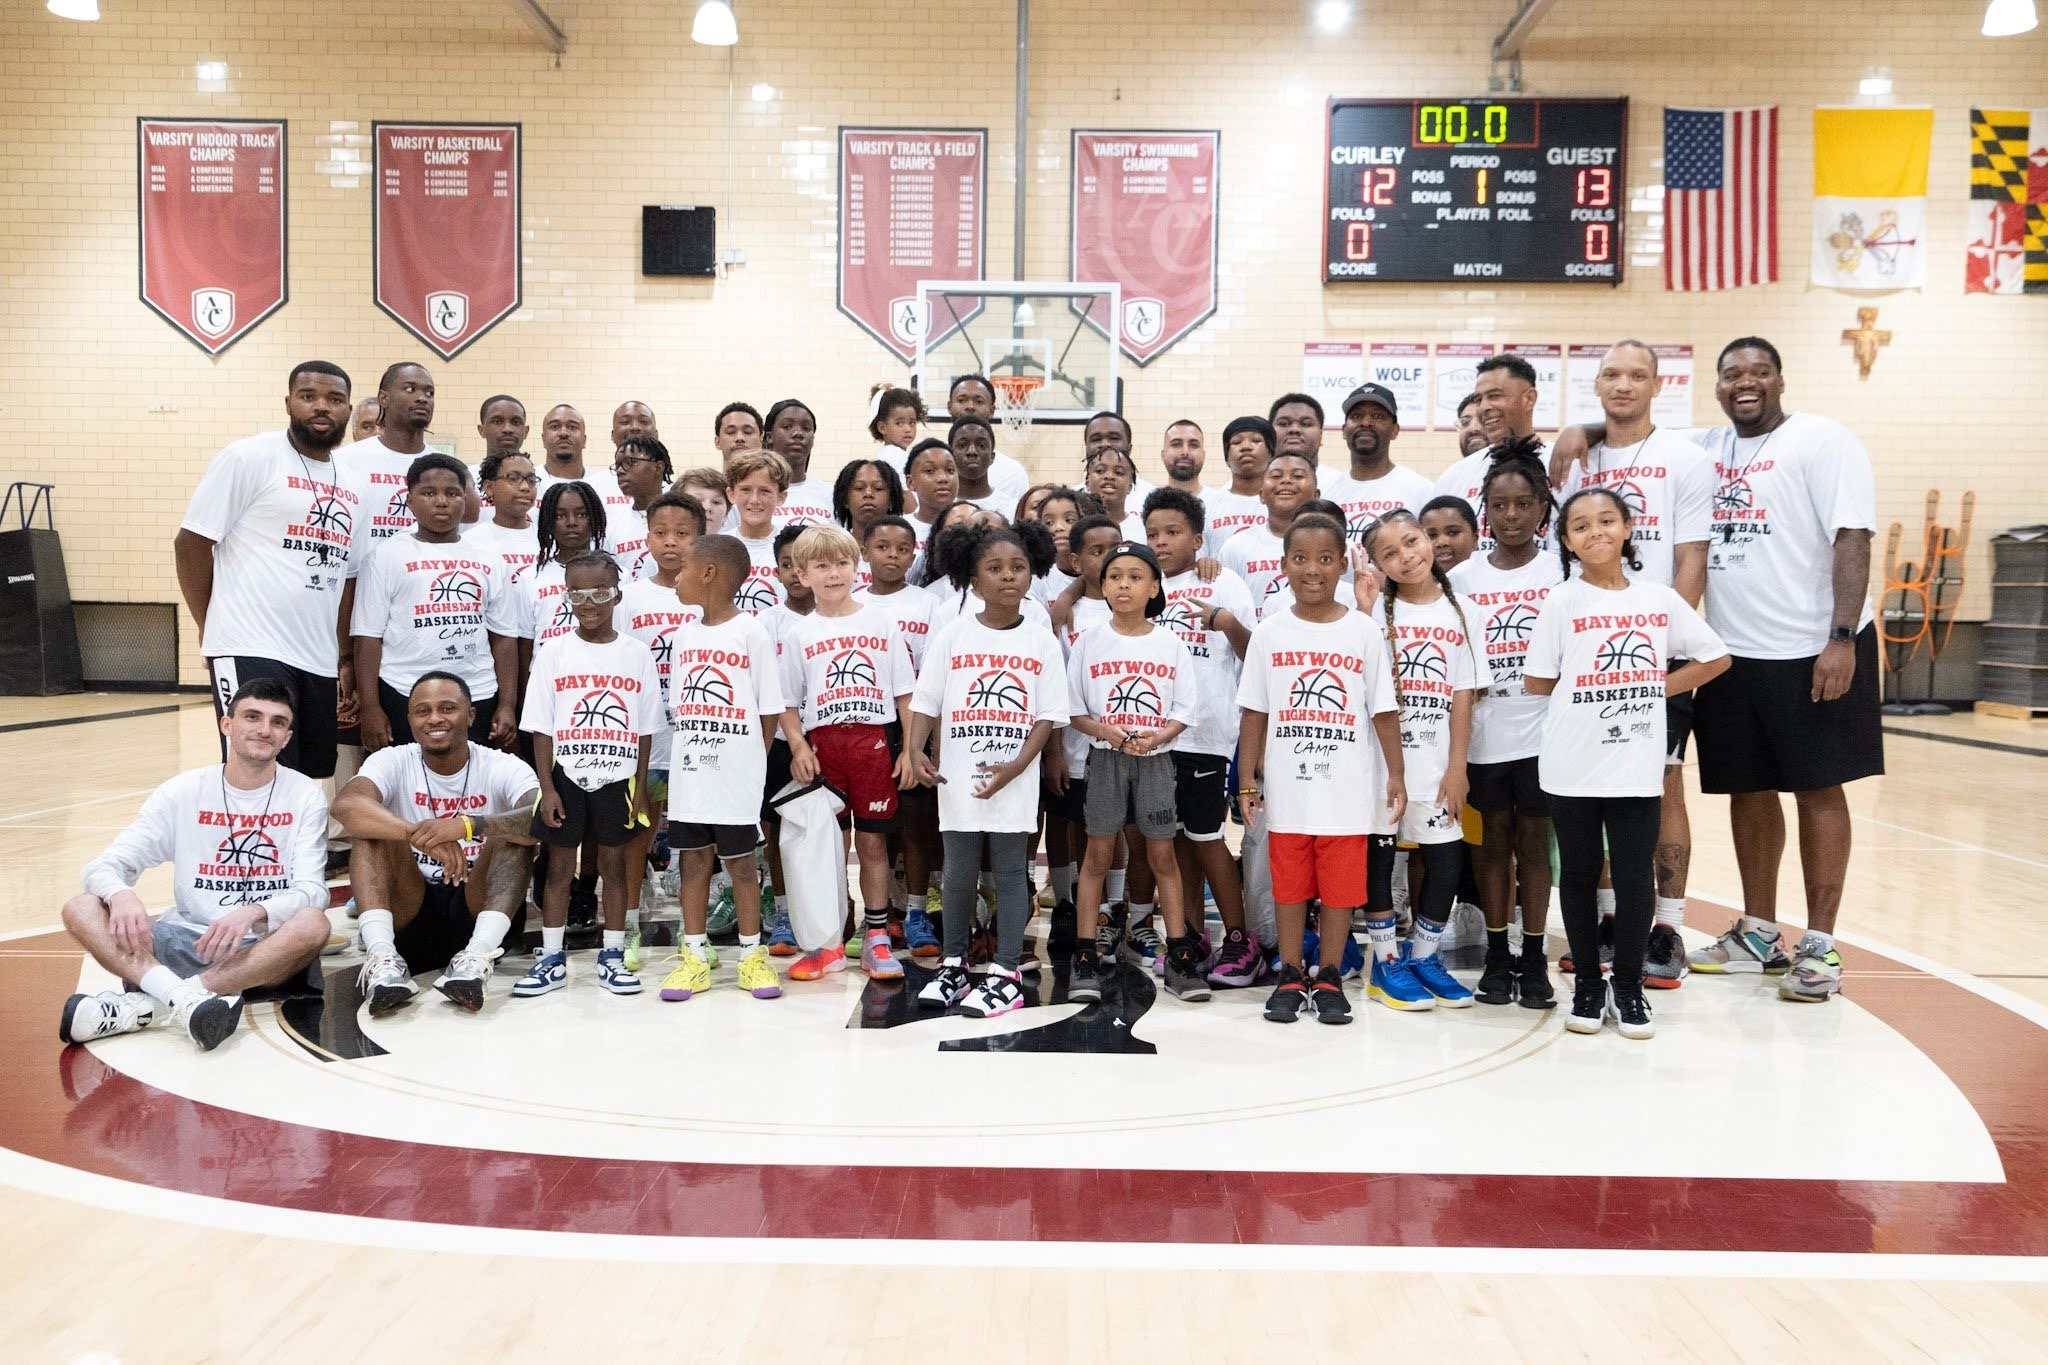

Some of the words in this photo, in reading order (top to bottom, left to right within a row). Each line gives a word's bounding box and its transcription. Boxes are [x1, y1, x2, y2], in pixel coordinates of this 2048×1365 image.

[1420, 106, 1507, 143] 00.0
[150, 132, 193, 146] VARSITY
[196, 133, 238, 147] INDOOR
[240, 134, 275, 148] TRACK
[390, 136, 434, 150] VARSITY
[438, 137, 502, 151] BASKETBALL
[190, 148, 235, 161] CHAMPS
[850, 142, 894, 155] VARSITY
[896, 142, 932, 156] TRACK
[934, 142, 942, 156] &
[945, 142, 976, 156] FIELD
[1093, 143, 1138, 157] VARSITY
[1140, 143, 1198, 158] SWIMMING
[1331, 147, 1406, 164] CURLEY
[424, 151, 469, 165] CHAMPS
[890, 156, 936, 170] CHAMPS
[1450, 156, 1500, 168] PERIOD
[1546, 148, 1617, 165] GUEST
[196, 166, 234, 174] CONFERENCE
[1122, 158, 1168, 172] CHAMPS
[430, 170, 468, 178] CONFERENCE
[1412, 171, 1444, 184] POSS
[1504, 171, 1537, 184] POSS
[1363, 168, 1396, 206] 12
[1477, 169, 1487, 204] 1
[1576, 168, 1610, 206] 13
[1412, 192, 1452, 204] BONUS
[1496, 192, 1536, 204] BONUS
[1331, 208, 1374, 220] FOULS
[1436, 208, 1490, 220] PLAYER
[1498, 208, 1532, 220] FOUL
[1571, 209, 1615, 222] FOULS
[1346, 223, 1370, 260] 0
[1586, 224, 1609, 261] 0
[1329, 264, 1377, 276] SCORE
[1454, 264, 1502, 276] MATCH
[1565, 264, 1614, 276] SCORE
[1376, 368, 1422, 380] WOLF
[1323, 377, 1357, 388] WCS
[1582, 466, 1667, 488] HAYWOOD
[287, 476, 358, 505] HAYWOOD
[1341, 501, 1404, 512] AYWOOD
[373, 516, 416, 527] HIGHS
[1212, 515, 1268, 529] HAYWO
[406, 560, 492, 576] HAYWOOD
[8, 573, 34, 584] SPALDING
[415, 602, 482, 614] HIGHSMT
[414, 614, 484, 628] BASKETBA
[632, 613, 698, 630] HAYWO
[1572, 614, 1668, 633] HAYWOOD
[952, 654, 1042, 676] HAYWOOD
[1272, 652, 1364, 674] HAYWOOD
[1576, 669, 1667, 688] HIGHSMITH
[817, 700, 886, 721] BASKETBALL
[1278, 709, 1356, 726] HIGHSMITH
[1600, 702, 1654, 719] CAMP
[556, 728, 638, 744] HIGHSMITH
[951, 726, 1030, 740] BASKETBA
[684, 734, 726, 749] AMP
[970, 740, 1018, 755] CAMP
[1294, 742, 1338, 757] CAMP
[574, 758, 622, 772] CAMP
[198, 810, 294, 828] HAYWOOD
